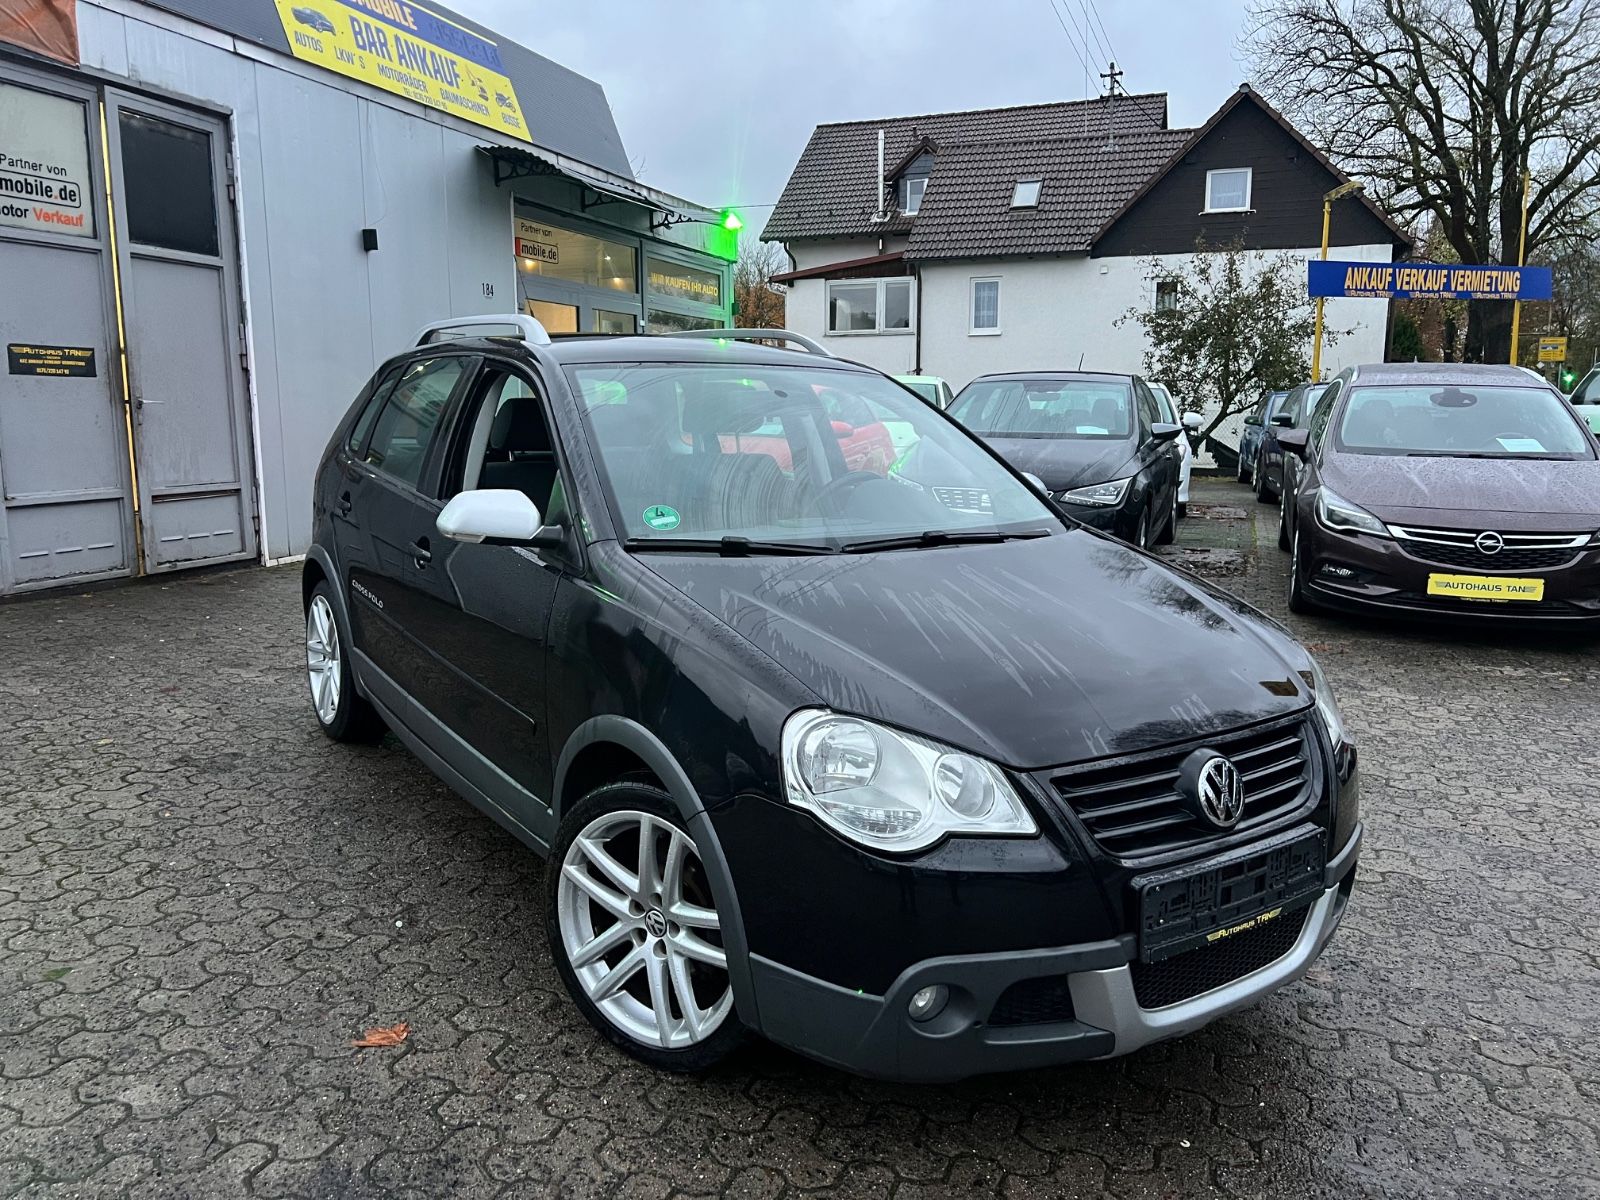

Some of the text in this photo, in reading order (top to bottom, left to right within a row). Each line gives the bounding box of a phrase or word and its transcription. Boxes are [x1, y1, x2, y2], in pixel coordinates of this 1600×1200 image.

[294, 30, 324, 54] AUTOS
[376, 62, 429, 94] MOTORRÄDER
[348, 14, 394, 63] BAR
[393, 32, 461, 90] ANKAUF
[0, 153, 67, 177] Partner von
[0, 177, 77, 202] mobile.de
[0, 203, 84, 227] otor Verkauf
[520, 221, 553, 238] Partner von
[521, 243, 557, 261] mobile.de
[481, 282, 494, 297] 184
[651, 271, 719, 297] WIR KAUFEN IHR AUTO
[1344, 266, 1520, 292] ANKAUF VERKAUF VERMIETUNG
[352, 579, 384, 609] CROSS POLO
[1444, 581, 1526, 593] AUTOHAUS TAN
[1256, 911, 1272, 924] TAN
